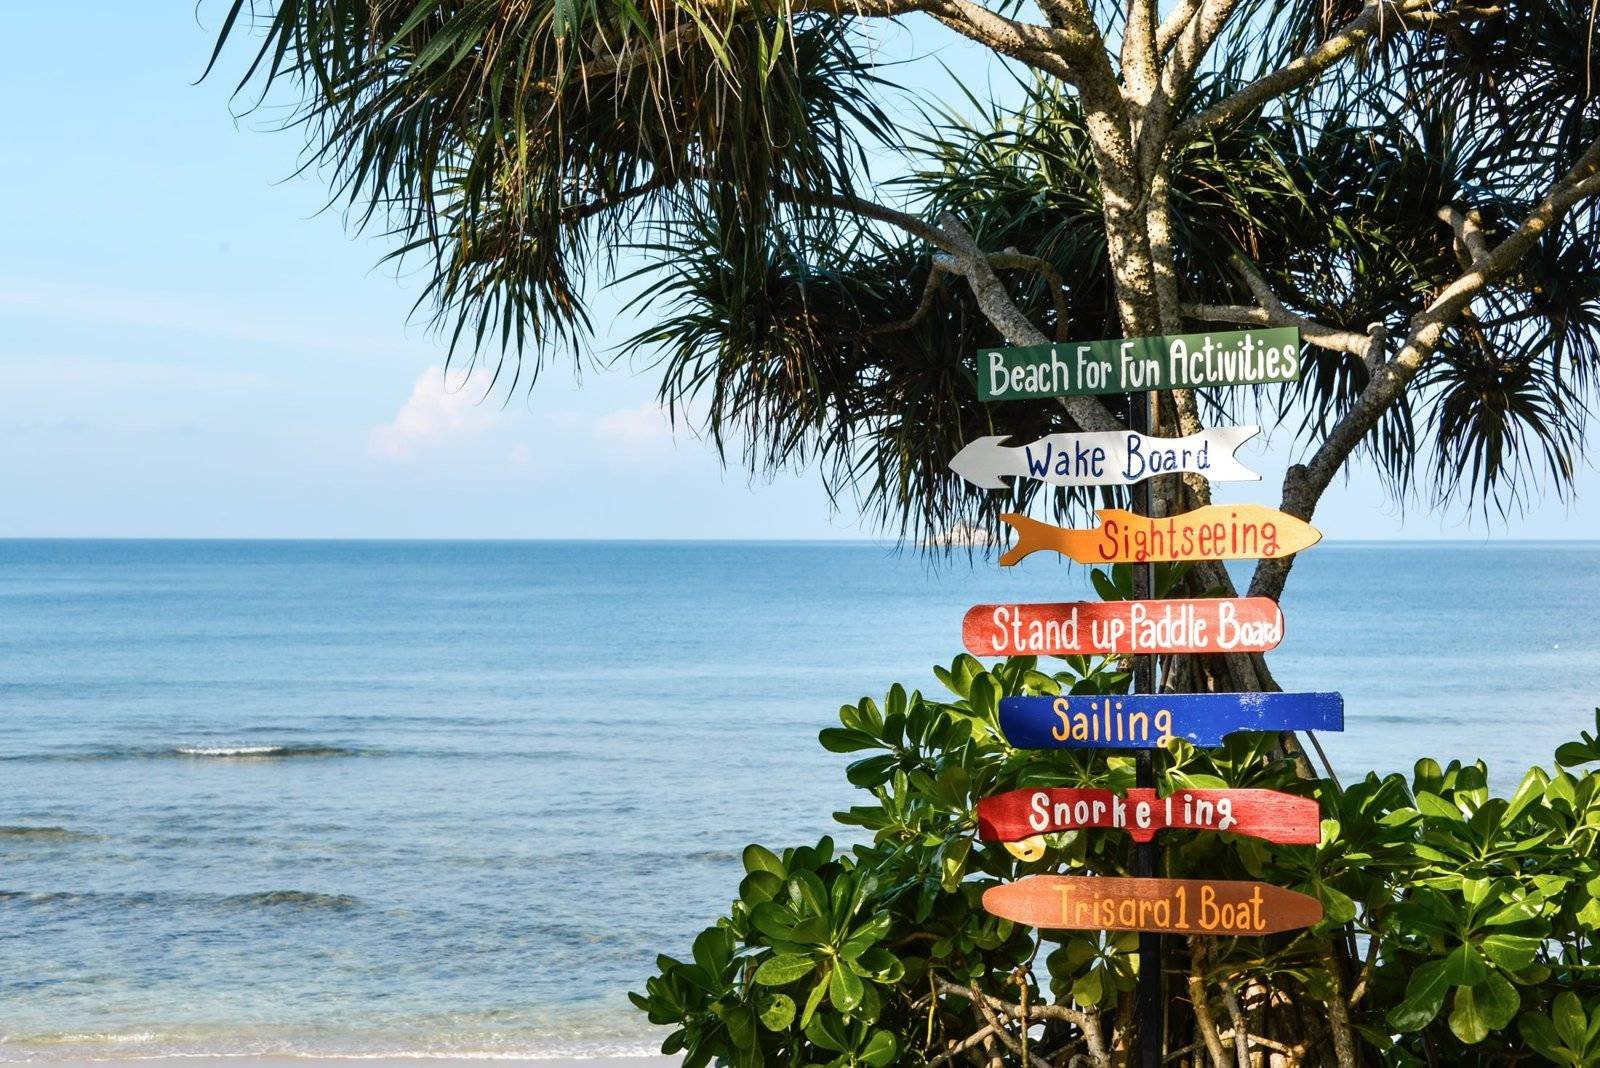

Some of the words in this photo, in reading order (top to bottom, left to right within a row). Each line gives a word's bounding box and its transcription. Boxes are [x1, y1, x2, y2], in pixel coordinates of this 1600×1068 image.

[988, 351, 1069, 396] Beach
[1077, 346, 1112, 389] For
[1120, 342, 1160, 388] Fun
[1169, 334, 1298, 385] Activities
[1025, 440, 1106, 479] Wake
[1122, 434, 1210, 481] Board
[1099, 512, 1280, 561] Sightseeing
[992, 606, 1081, 651] Stand
[1092, 626, 1125, 652] up
[1130, 602, 1209, 650] Paddle
[1216, 601, 1281, 649] Board
[1052, 698, 1173, 747] Sailing
[1029, 792, 1238, 831] Snorkeling
[1199, 885, 1266, 930] Boat
